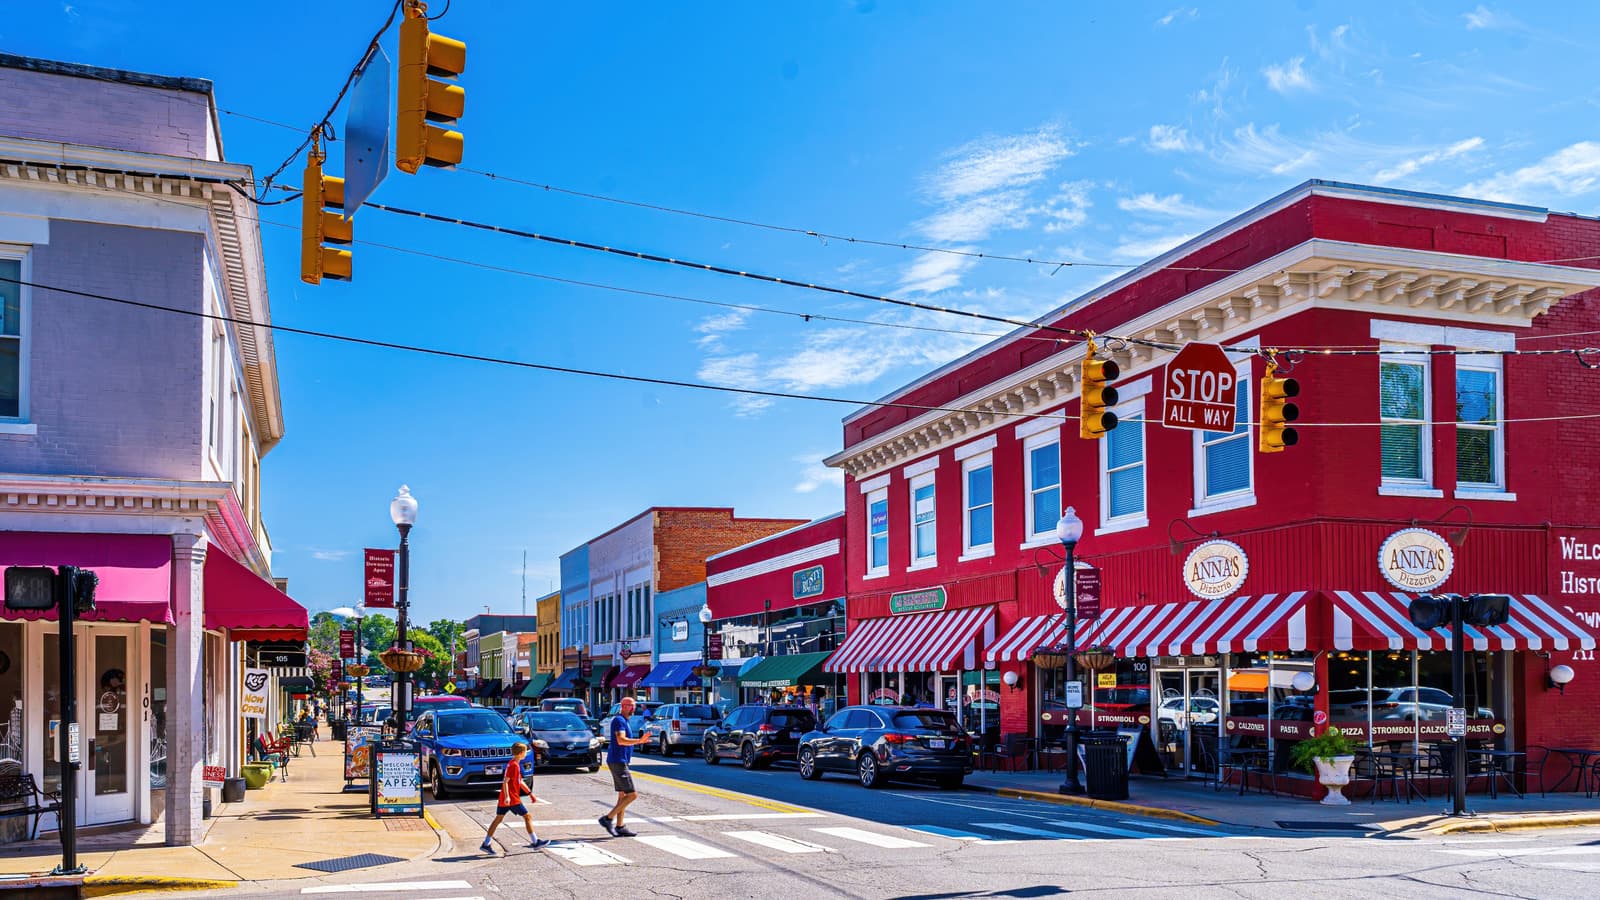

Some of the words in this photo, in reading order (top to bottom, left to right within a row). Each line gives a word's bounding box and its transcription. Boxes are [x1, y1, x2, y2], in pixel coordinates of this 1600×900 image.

[1170, 368, 1232, 402] STOP
[1170, 405, 1195, 423] ALL
[1204, 408, 1229, 426] WAY
[1560, 536, 1600, 560] WELC
[1389, 548, 1445, 571] ANNA'S
[1191, 555, 1240, 582] ANNA'S
[1399, 572, 1437, 586] Pizzeria
[1560, 571, 1600, 594] HIST
[1200, 582, 1232, 593] Pizzeria
[1133, 662, 1147, 671] 100
[245, 694, 265, 704] NOW
[241, 704, 265, 715] OPEN
[1239, 722, 1265, 731] CALZONES
[1280, 725, 1299, 734] PASTA
[1341, 727, 1364, 735] PIZZA
[1420, 726, 1448, 734] CALZO
[384, 779, 415, 787] APEX
